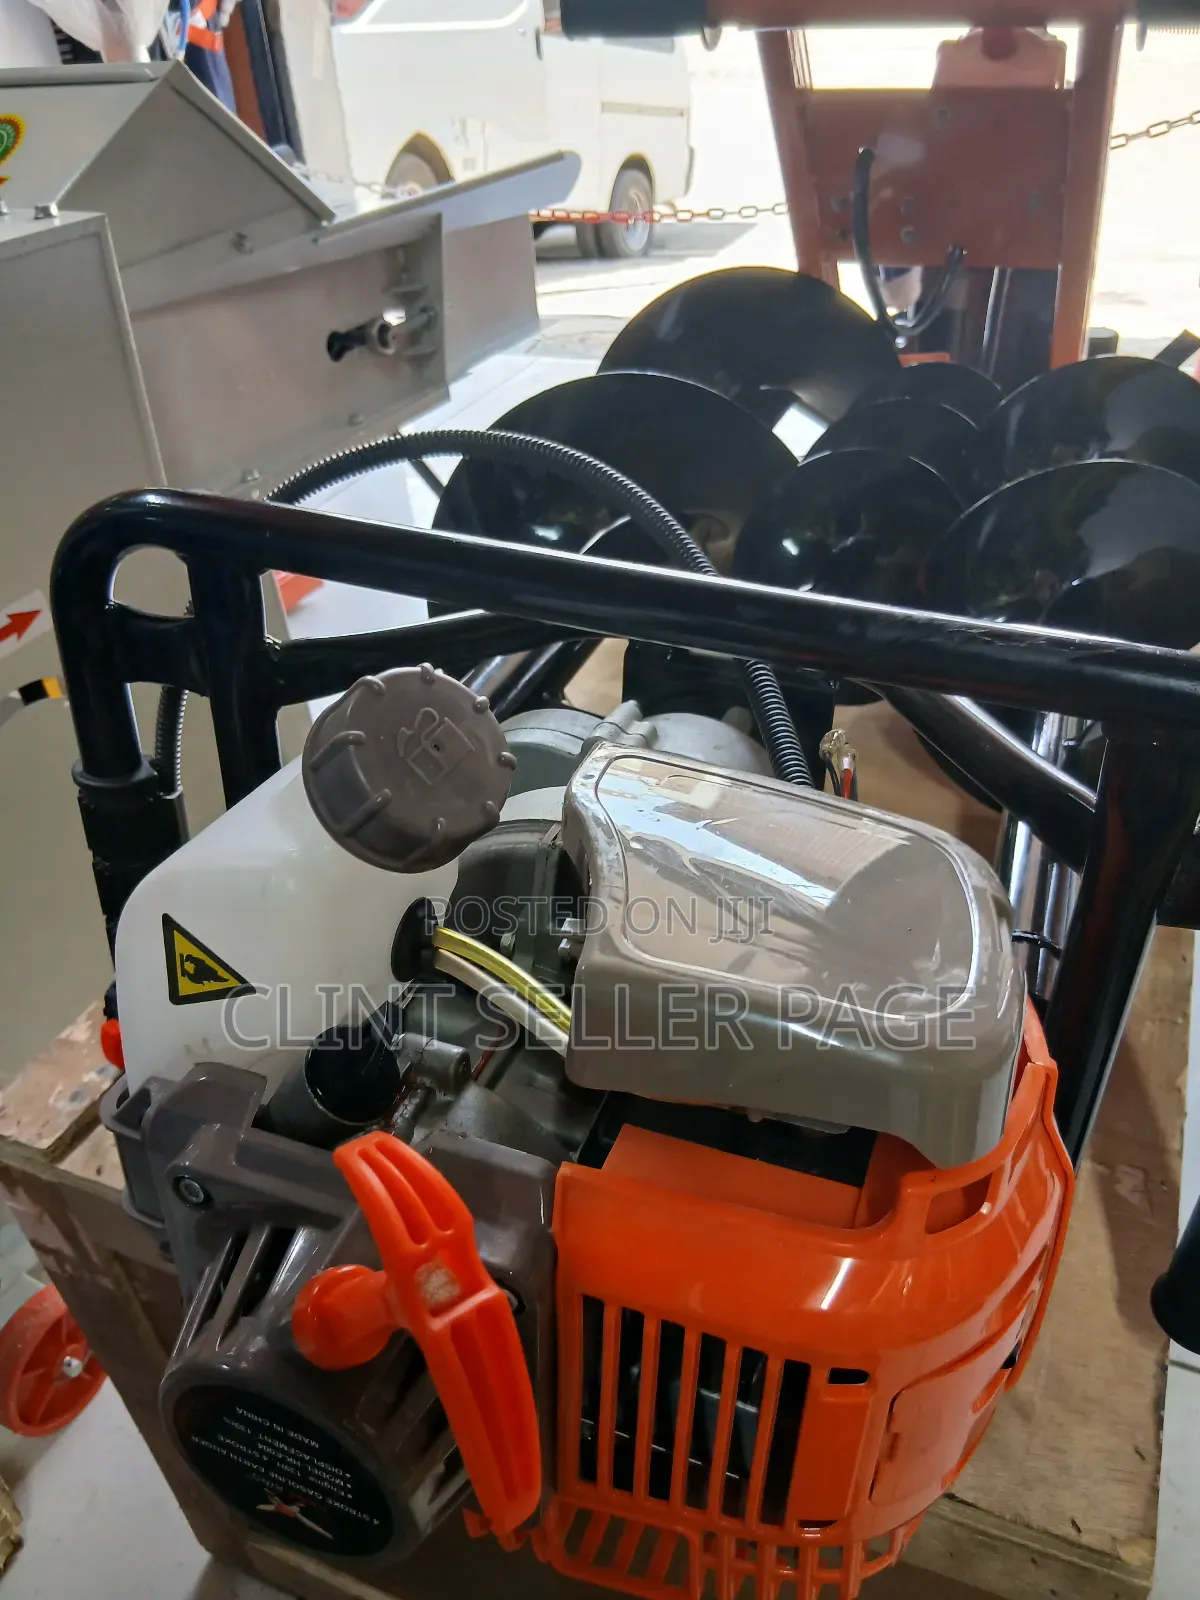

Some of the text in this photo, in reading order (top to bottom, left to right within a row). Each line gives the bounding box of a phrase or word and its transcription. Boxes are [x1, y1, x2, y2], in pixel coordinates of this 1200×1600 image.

[235, 1406, 319, 1449] MADE IN CHINA
[269, 1471, 323, 1500] GASOLINE
[325, 1497, 371, 1522] STROKE
